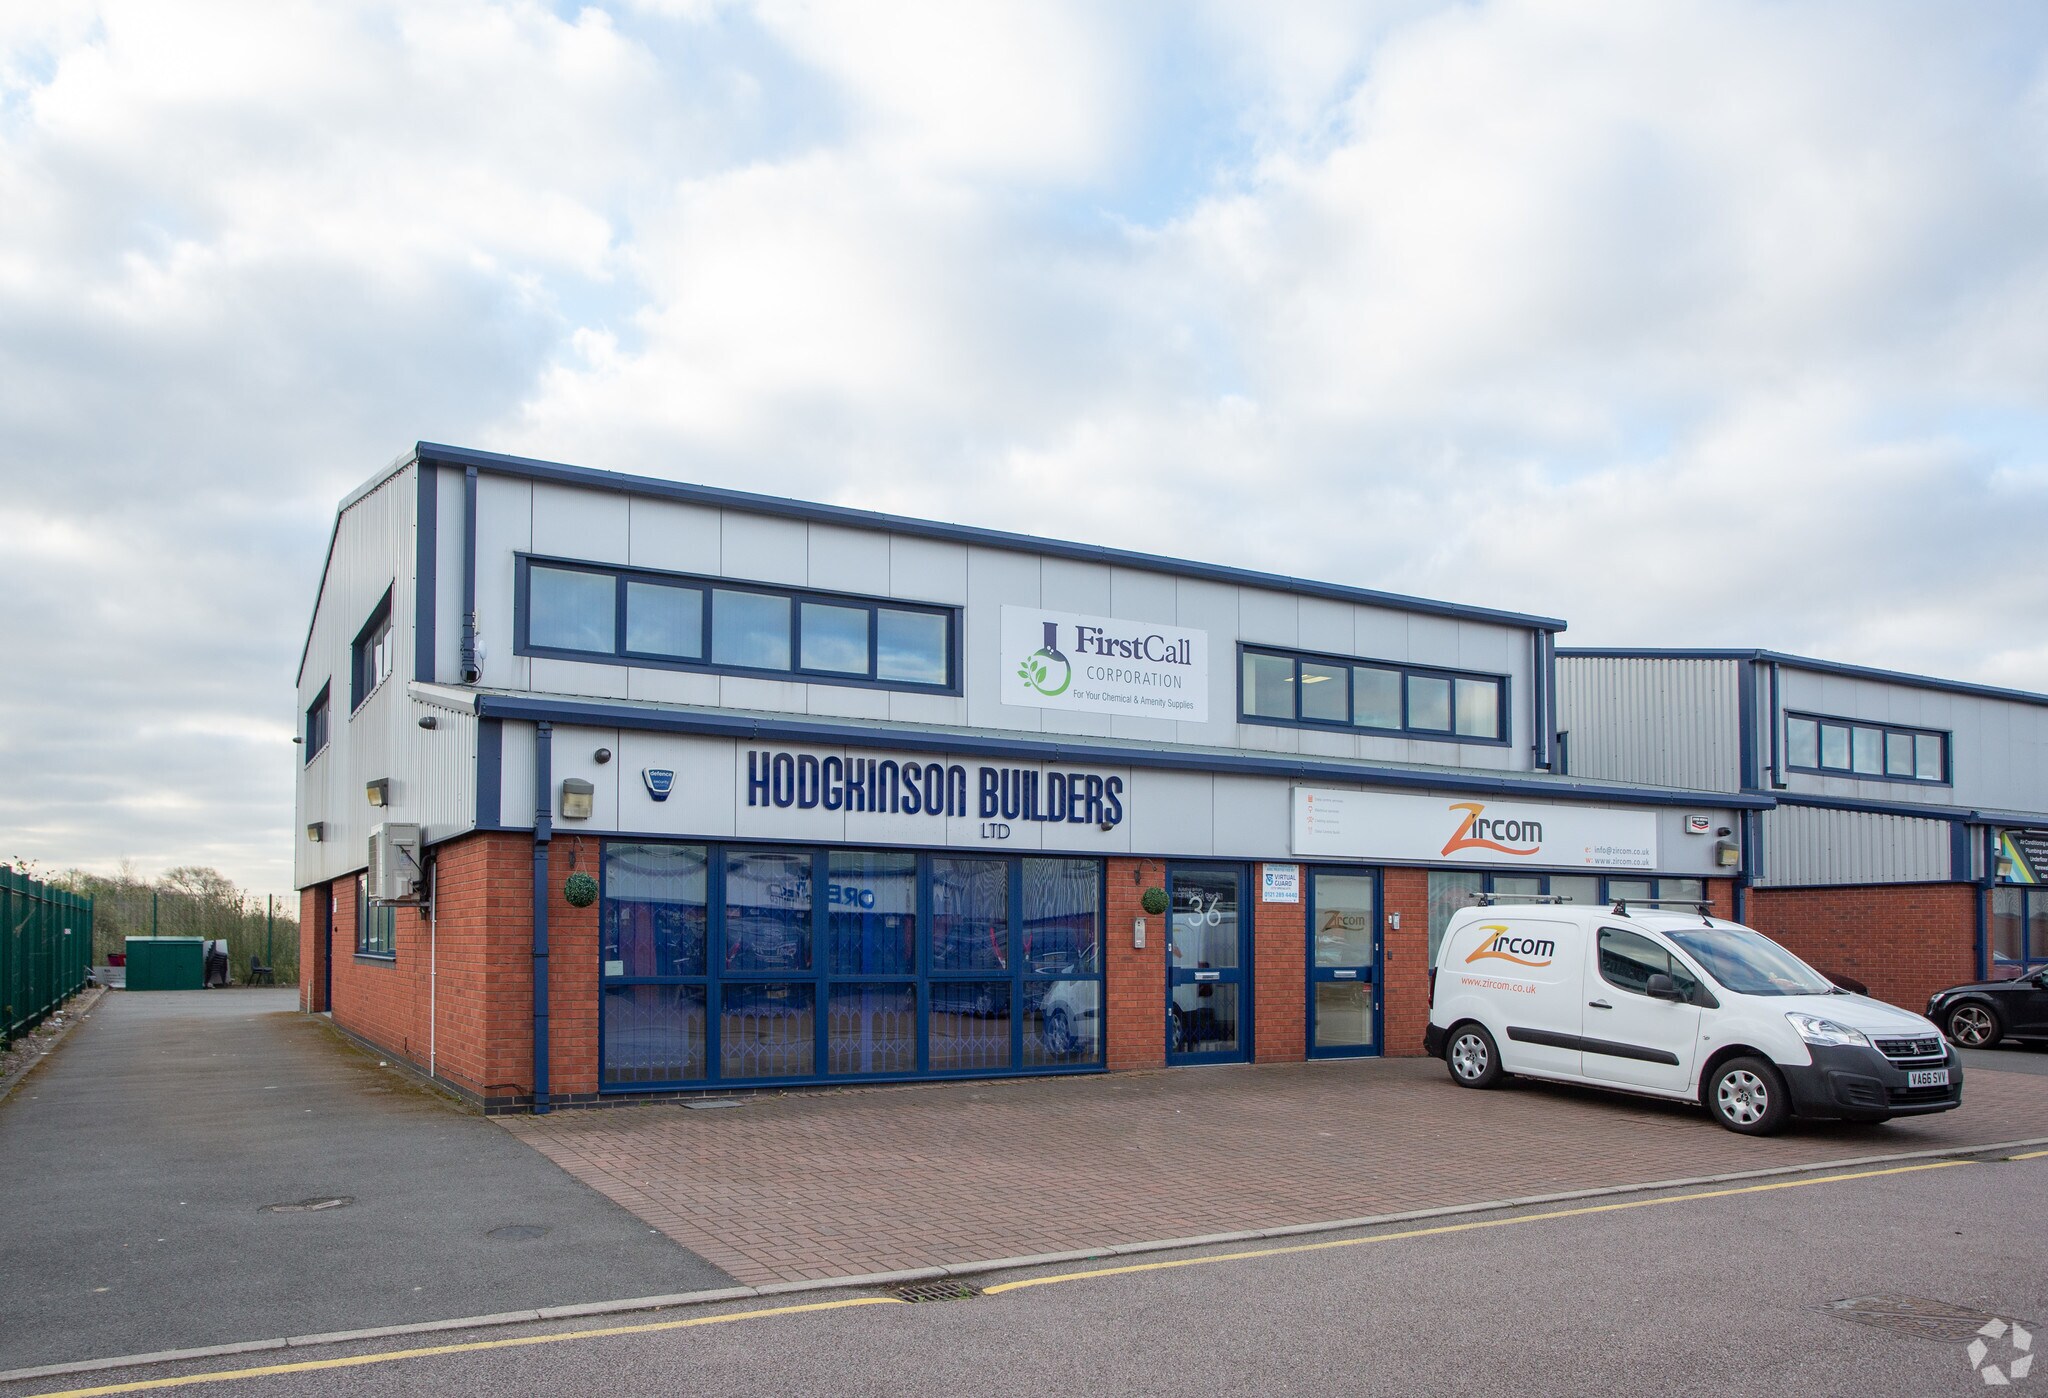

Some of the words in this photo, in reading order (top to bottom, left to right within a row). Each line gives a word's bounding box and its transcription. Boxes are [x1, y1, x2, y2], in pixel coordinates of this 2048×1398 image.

[1075, 625, 1192, 665] FirstCall
[1086, 665, 1182, 688] CORPORATION
[1073, 689, 1084, 699] For
[1085, 690, 1101, 701] Your
[1102, 691, 1132, 704] Chemical
[1133, 695, 1139, 704] &
[1140, 696, 1166, 708] Amenity
[1167, 699, 1194, 709] Supplies
[748, 750, 967, 817] HODGKINSON
[979, 766, 1123, 826] BUILDERS
[981, 822, 1011, 839] LTD
[1441, 802, 1543, 857] Zircom
[1594, 846, 1649, 855] info@zircom.co.uk
[1594, 857, 1649, 865] www.zircom.co.uk
[1188, 896, 1221, 927] 36
[1465, 925, 1555, 967] Zircom
[1461, 976, 1537, 994] www.zircom.co.uk
[1911, 1072, 1932, 1084] VA66
[1932, 1071, 1946, 1083] SVV
